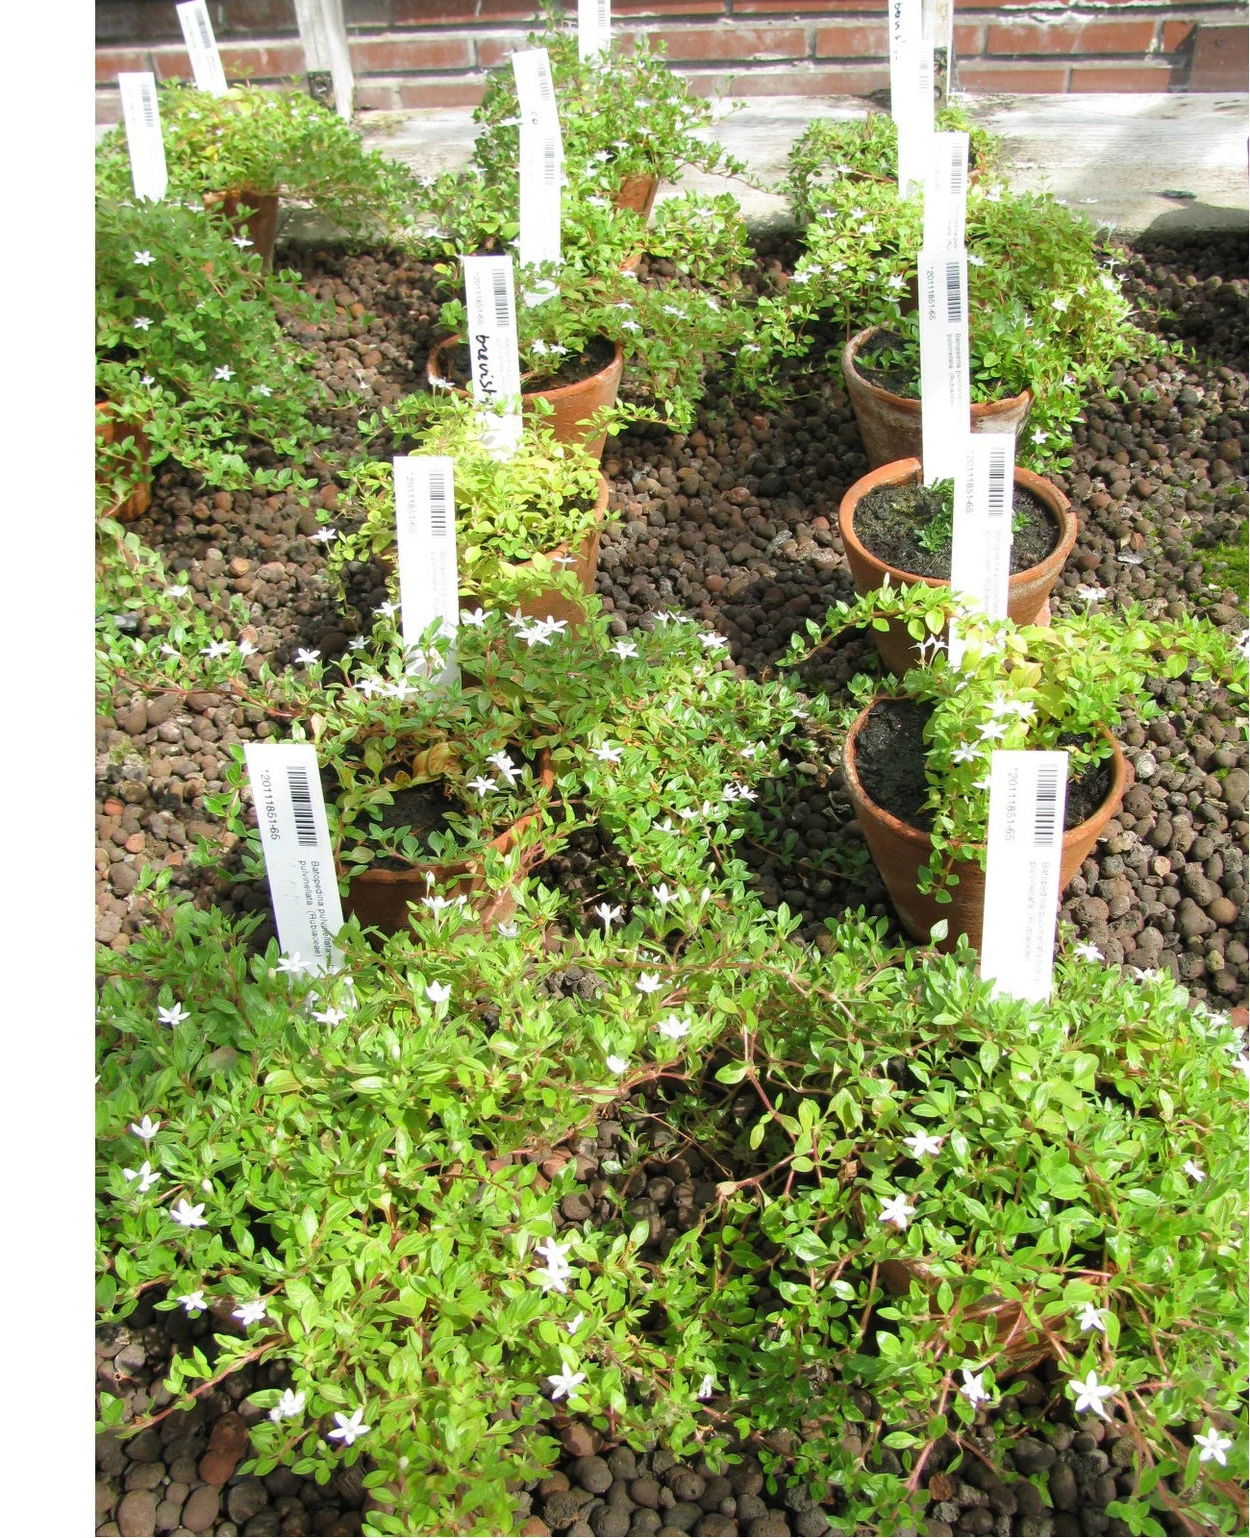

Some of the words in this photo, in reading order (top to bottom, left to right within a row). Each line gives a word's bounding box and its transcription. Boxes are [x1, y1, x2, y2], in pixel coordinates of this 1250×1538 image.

[306, 910, 322, 958] (Rubiaceae)
[311, 861, 324, 906] Batopedina
[319, 909, 332, 953] pulvellata
